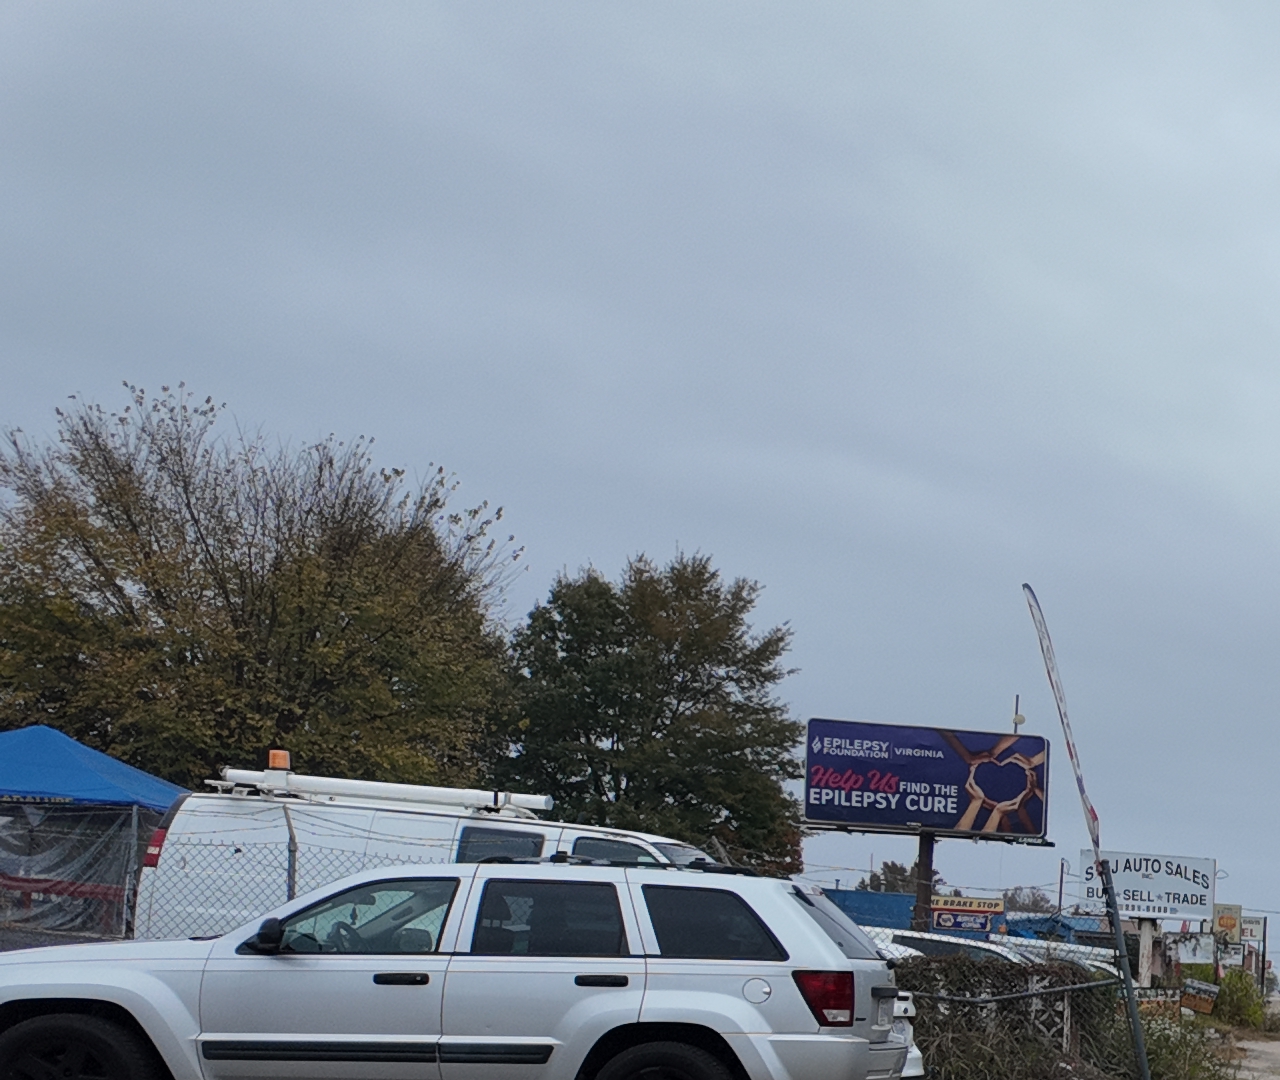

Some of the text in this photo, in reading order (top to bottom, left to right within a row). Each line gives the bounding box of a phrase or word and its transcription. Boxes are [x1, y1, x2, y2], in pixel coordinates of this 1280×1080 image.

[823, 737, 889, 751] EPILEPSY
[823, 747, 944, 759] FOUNDATION VIRGINIA
[811, 765, 958, 796] Help Us FIND THE
[809, 788, 958, 814] EPILEPSY CURE
[1122, 858, 1161, 873] AUTO
[1164, 861, 1210, 890] SALES
[942, 900, 974, 908] BRAKE
[976, 901, 1000, 909] STOP
[1086, 886, 1207, 906] BU SELL TRADE
